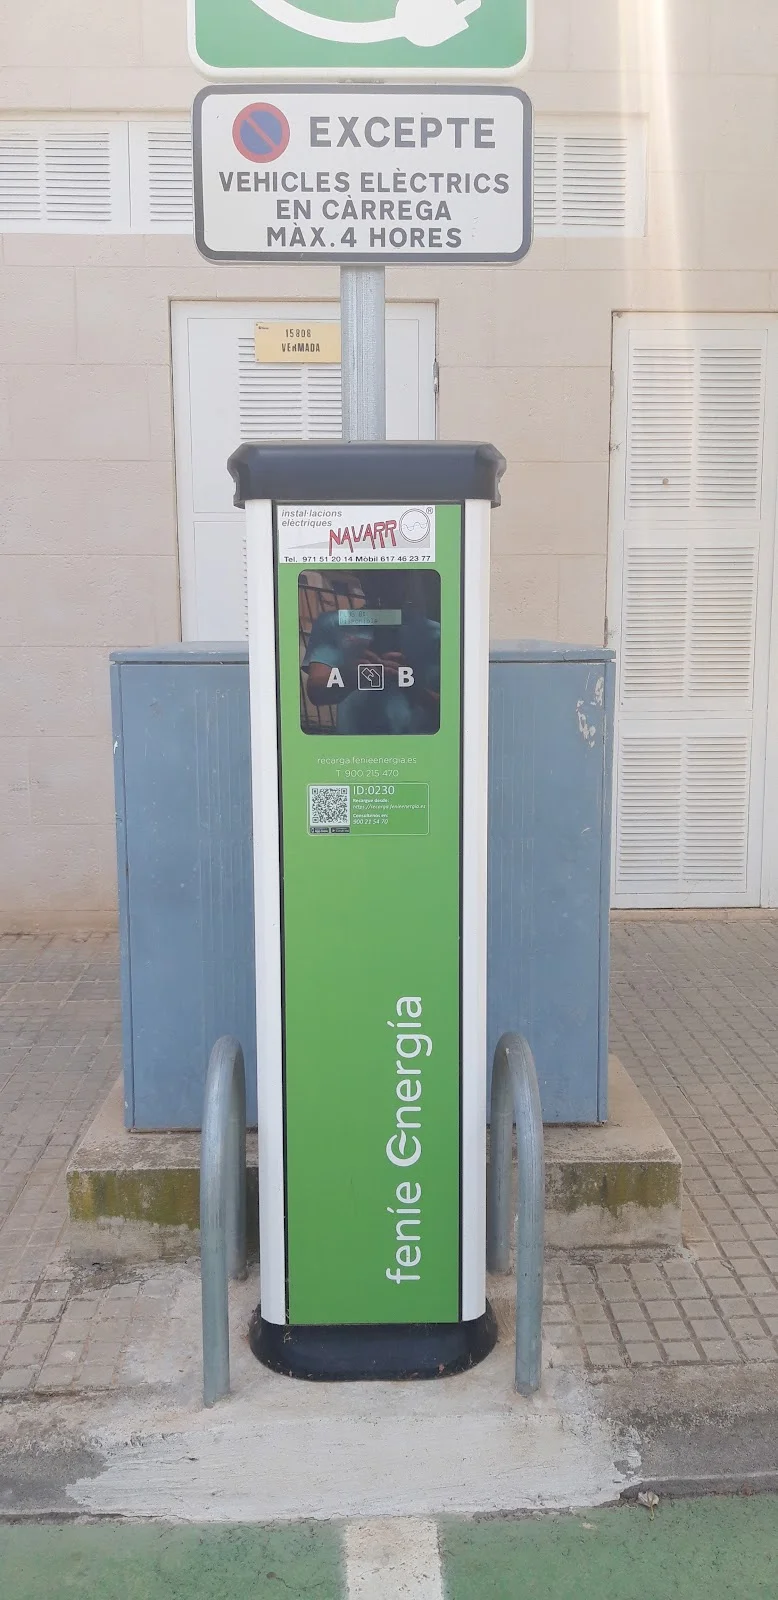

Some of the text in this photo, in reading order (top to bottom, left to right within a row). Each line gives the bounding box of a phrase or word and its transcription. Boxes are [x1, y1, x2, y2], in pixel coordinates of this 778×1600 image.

[309, 116, 496, 149] EXCEPTE
[218, 168, 510, 194] VEHICLES ELÈCTRICS
[276, 194, 452, 221] EN CÀRREGA
[369, 227, 462, 249] HORES
[285, 328, 311, 338] 15808
[326, 666, 415, 688] A B
[344, 769, 364, 778] 900
[366, 769, 380, 777] 215
[382, 769, 399, 777] 470
[353, 785, 395, 795] ID:0230
[386, 1181, 422, 1284] feníe
